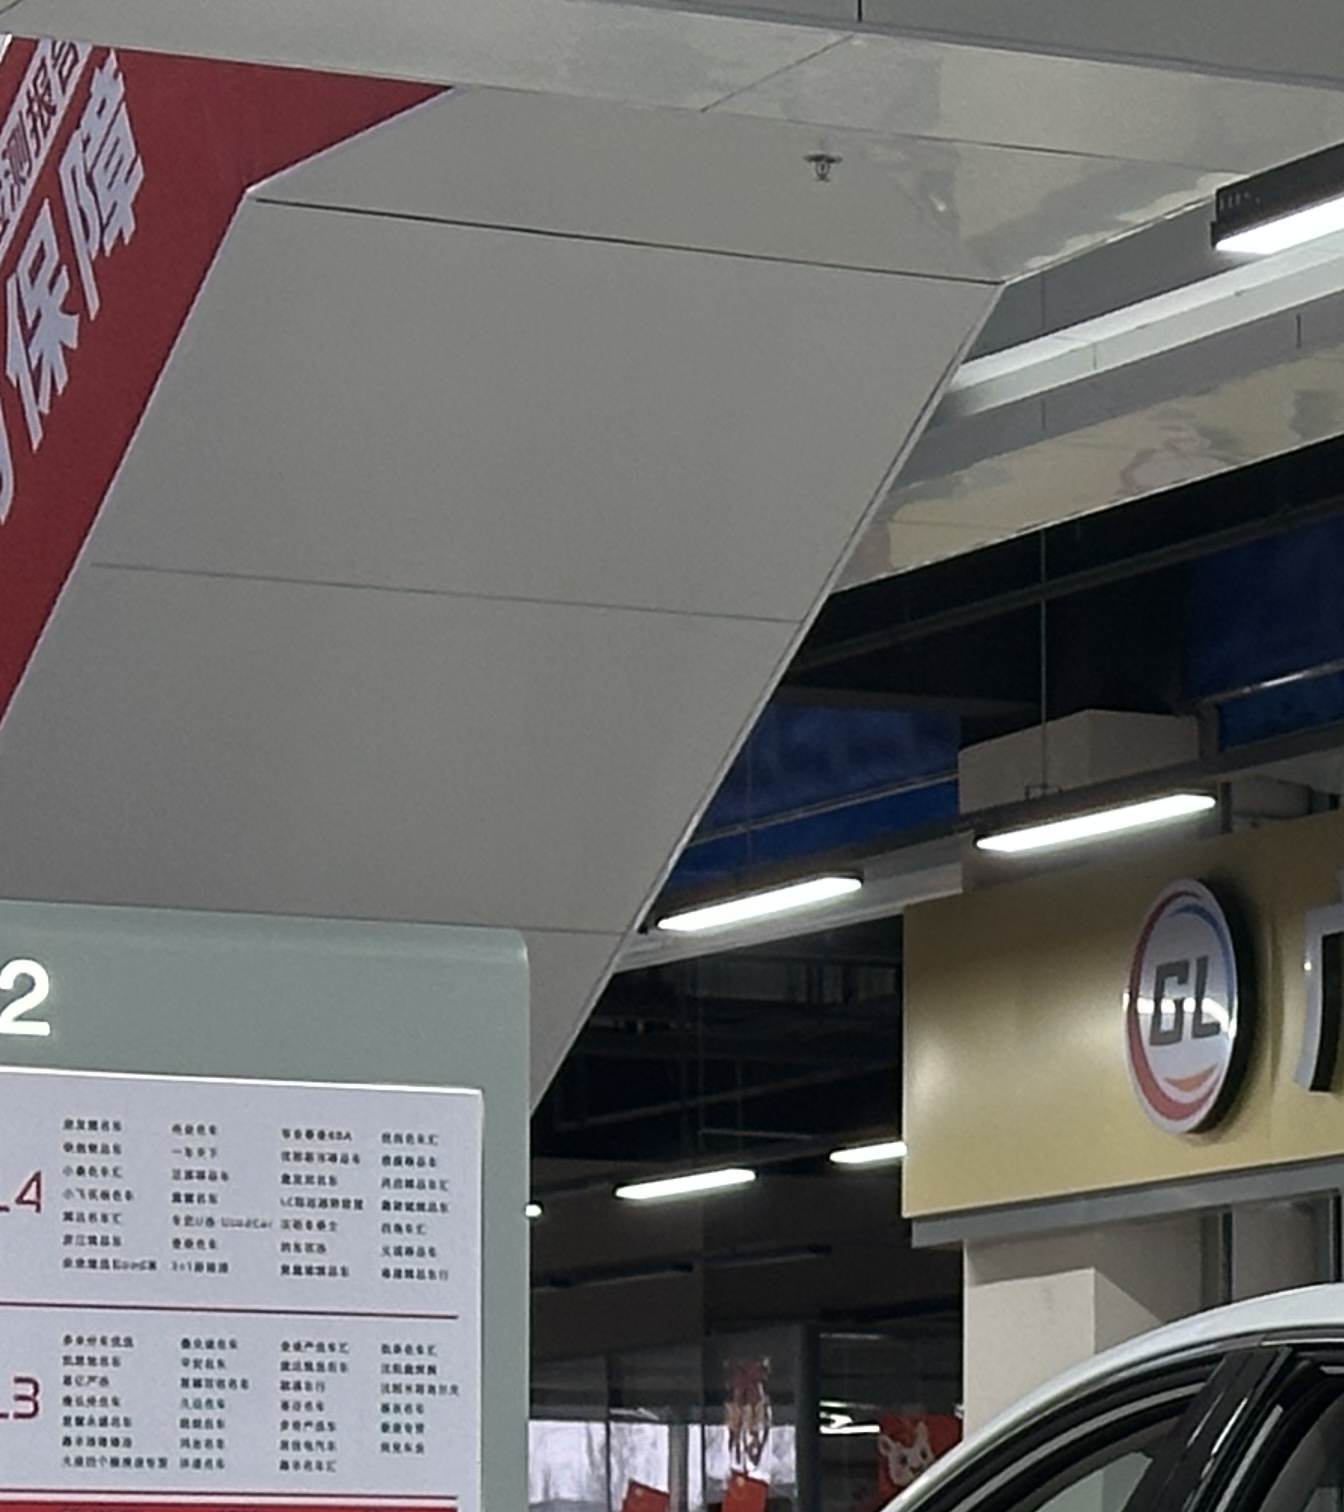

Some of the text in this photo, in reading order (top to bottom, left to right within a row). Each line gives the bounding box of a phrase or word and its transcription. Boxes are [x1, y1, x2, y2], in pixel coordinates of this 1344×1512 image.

[0, 40, 80, 240] 测报告
[0, 48, 146, 526] 保障
[0, 1170, 42, 1214] 4
[0, 1376, 40, 1420] 3
